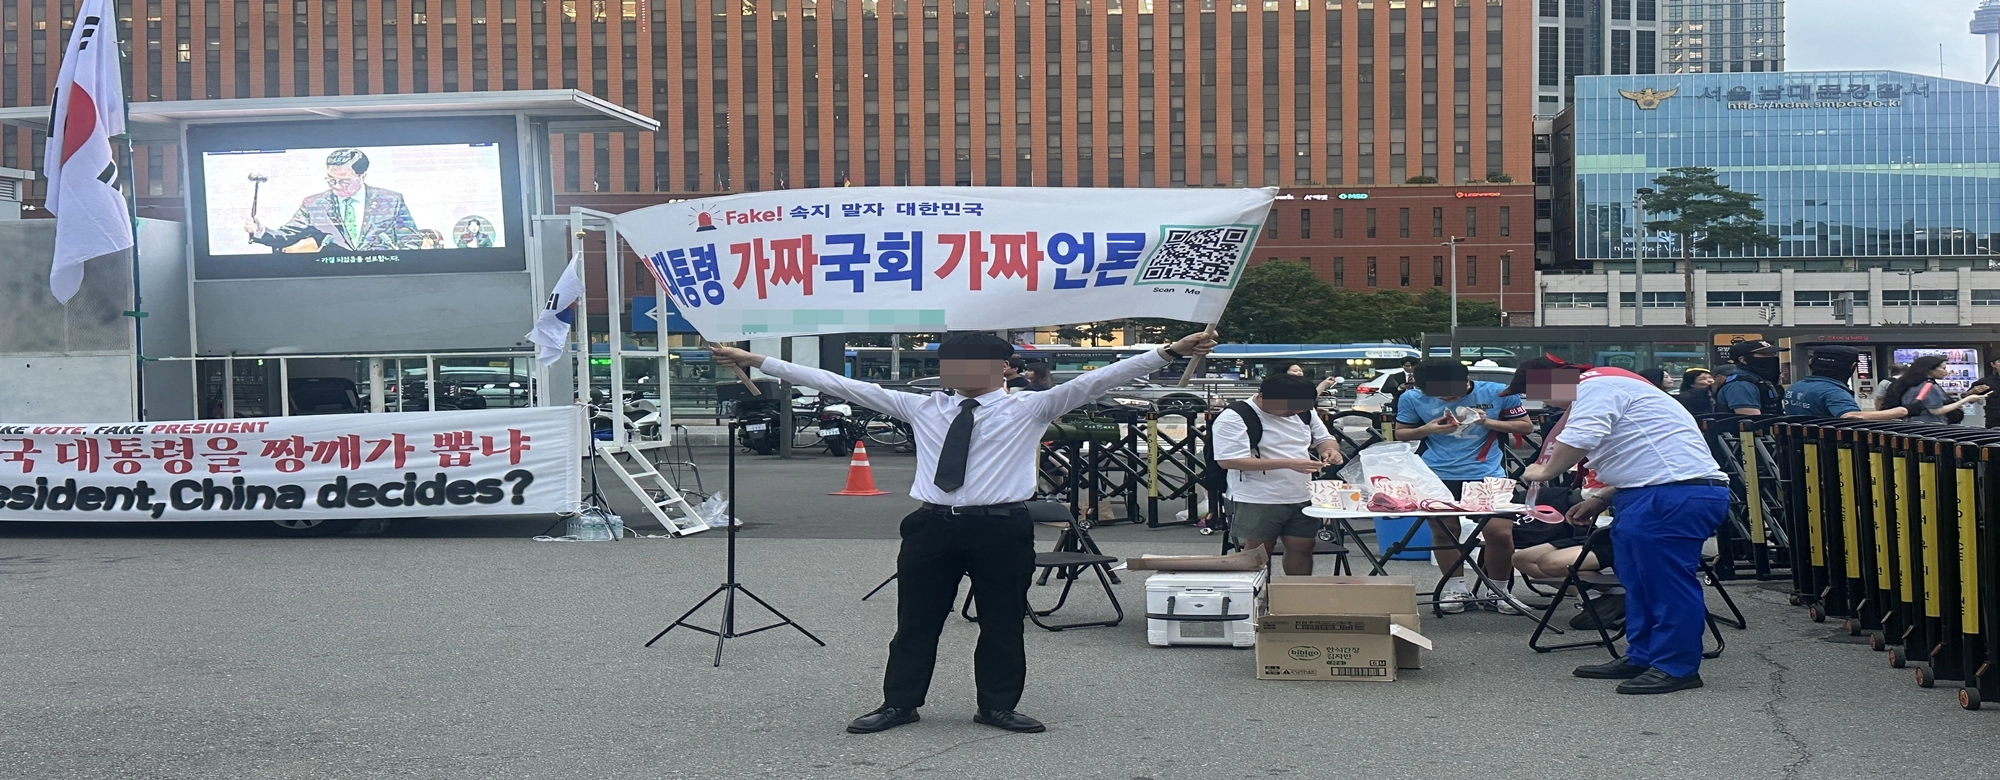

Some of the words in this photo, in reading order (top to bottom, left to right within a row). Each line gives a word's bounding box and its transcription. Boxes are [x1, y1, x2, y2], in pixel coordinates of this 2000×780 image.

[1698, 83, 1930, 101] 서울남대문경찰서
[1727, 100, 1902, 110] http://ndm.smpa.go.kr
[725, 206, 782, 225] Fake!
[789, 204, 830, 219] 속지
[841, 202, 885, 217] 말자
[896, 202, 984, 216] 대한민국
[642, 243, 725, 308] 대통령
[1184, 287, 1200, 295] Me
[0, 425, 29, 435] KE
[32, 426, 88, 436] VOTE,
[93, 424, 149, 435] FAKE
[150, 421, 269, 435] PRESIDENT
[55, 436, 248, 474] 대통령을
[260, 433, 415, 473] 짱깨가
[429, 428, 531, 468] 뽑냐
[316, 469, 534, 509] decides?
[1291, 649, 1319, 658] bibigo
